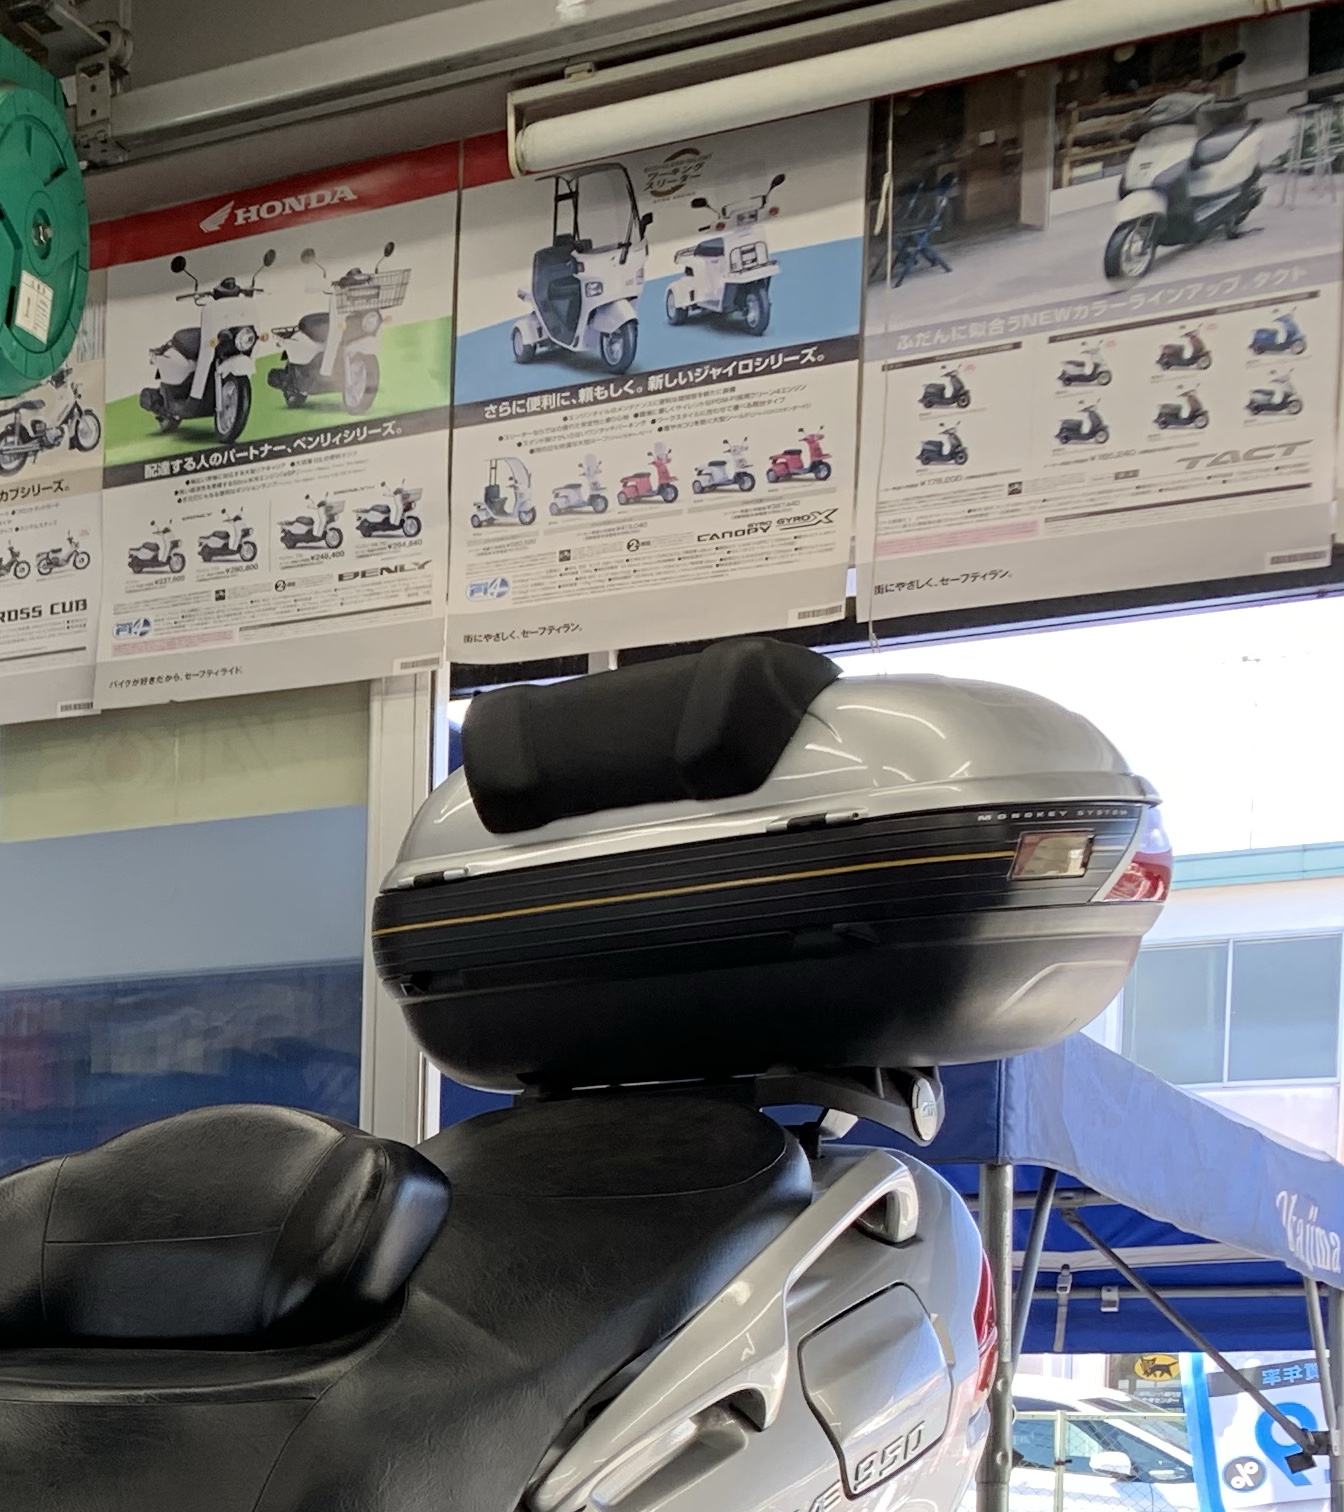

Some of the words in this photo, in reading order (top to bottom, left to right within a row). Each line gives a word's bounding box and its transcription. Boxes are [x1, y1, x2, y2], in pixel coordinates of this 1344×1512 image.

[234, 185, 358, 226] HONDA
[144, 420, 403, 480] 配達する人のパートナー、ベンリィシリーズ。
[1176, 439, 1313, 470] TACT
[697, 526, 771, 543] CANOPY
[337, 560, 433, 582] BENLY
[50, 598, 88, 616] CUB
[462, 620, 584, 645] 街にやさしく、セーフティラン。
[977, 810, 1068, 822] MONOKEY
[1077, 808, 1128, 817] SYSTEM
[853, 1421, 926, 1492] 650
